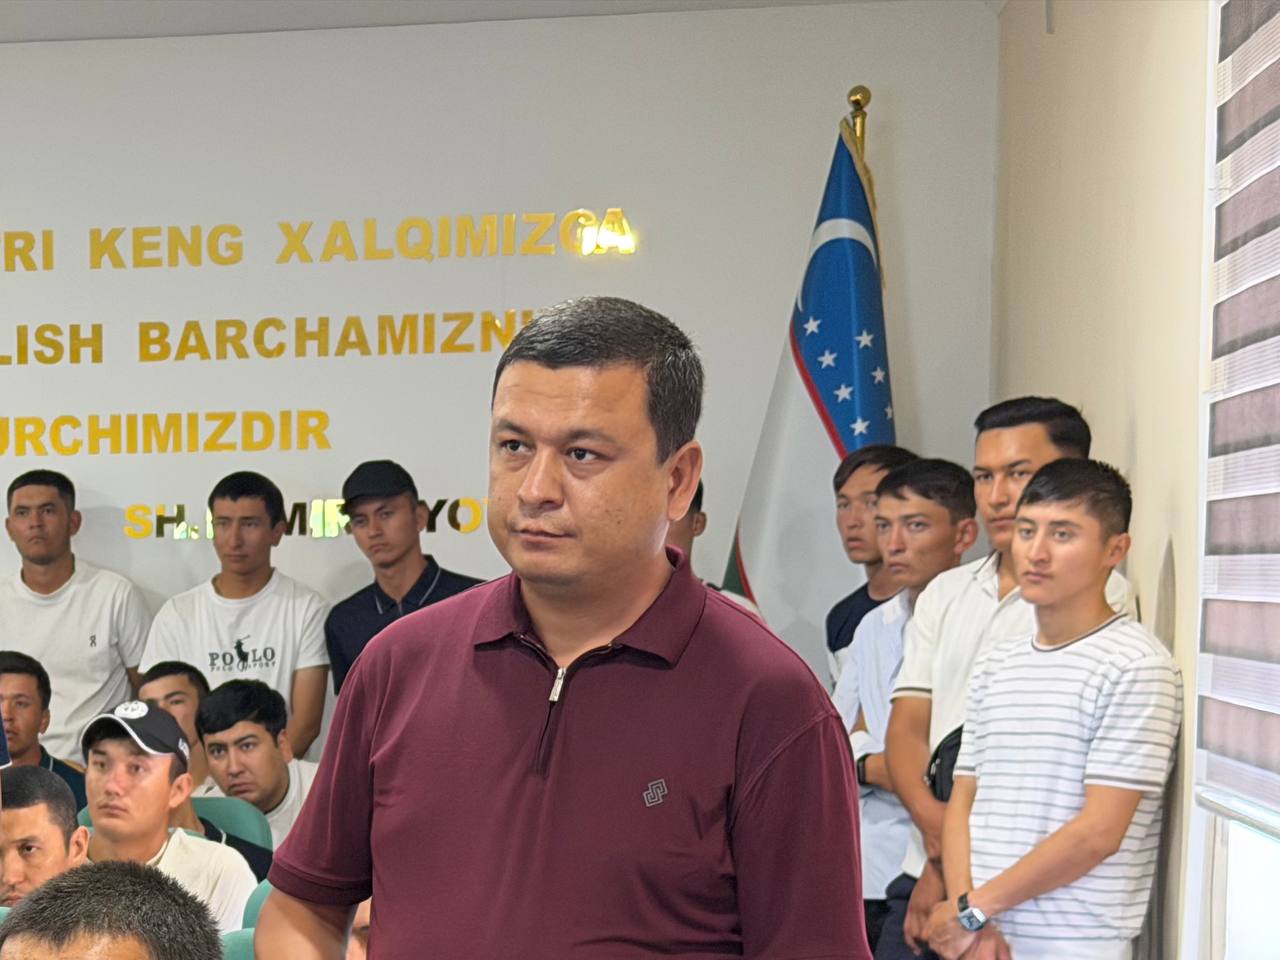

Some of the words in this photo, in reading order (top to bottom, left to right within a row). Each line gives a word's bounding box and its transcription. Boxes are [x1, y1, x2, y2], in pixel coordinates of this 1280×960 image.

[89, 225, 243, 269] KENG
[277, 207, 636, 264] XALQIMIZGA
[208, 647, 275, 667] POLO
